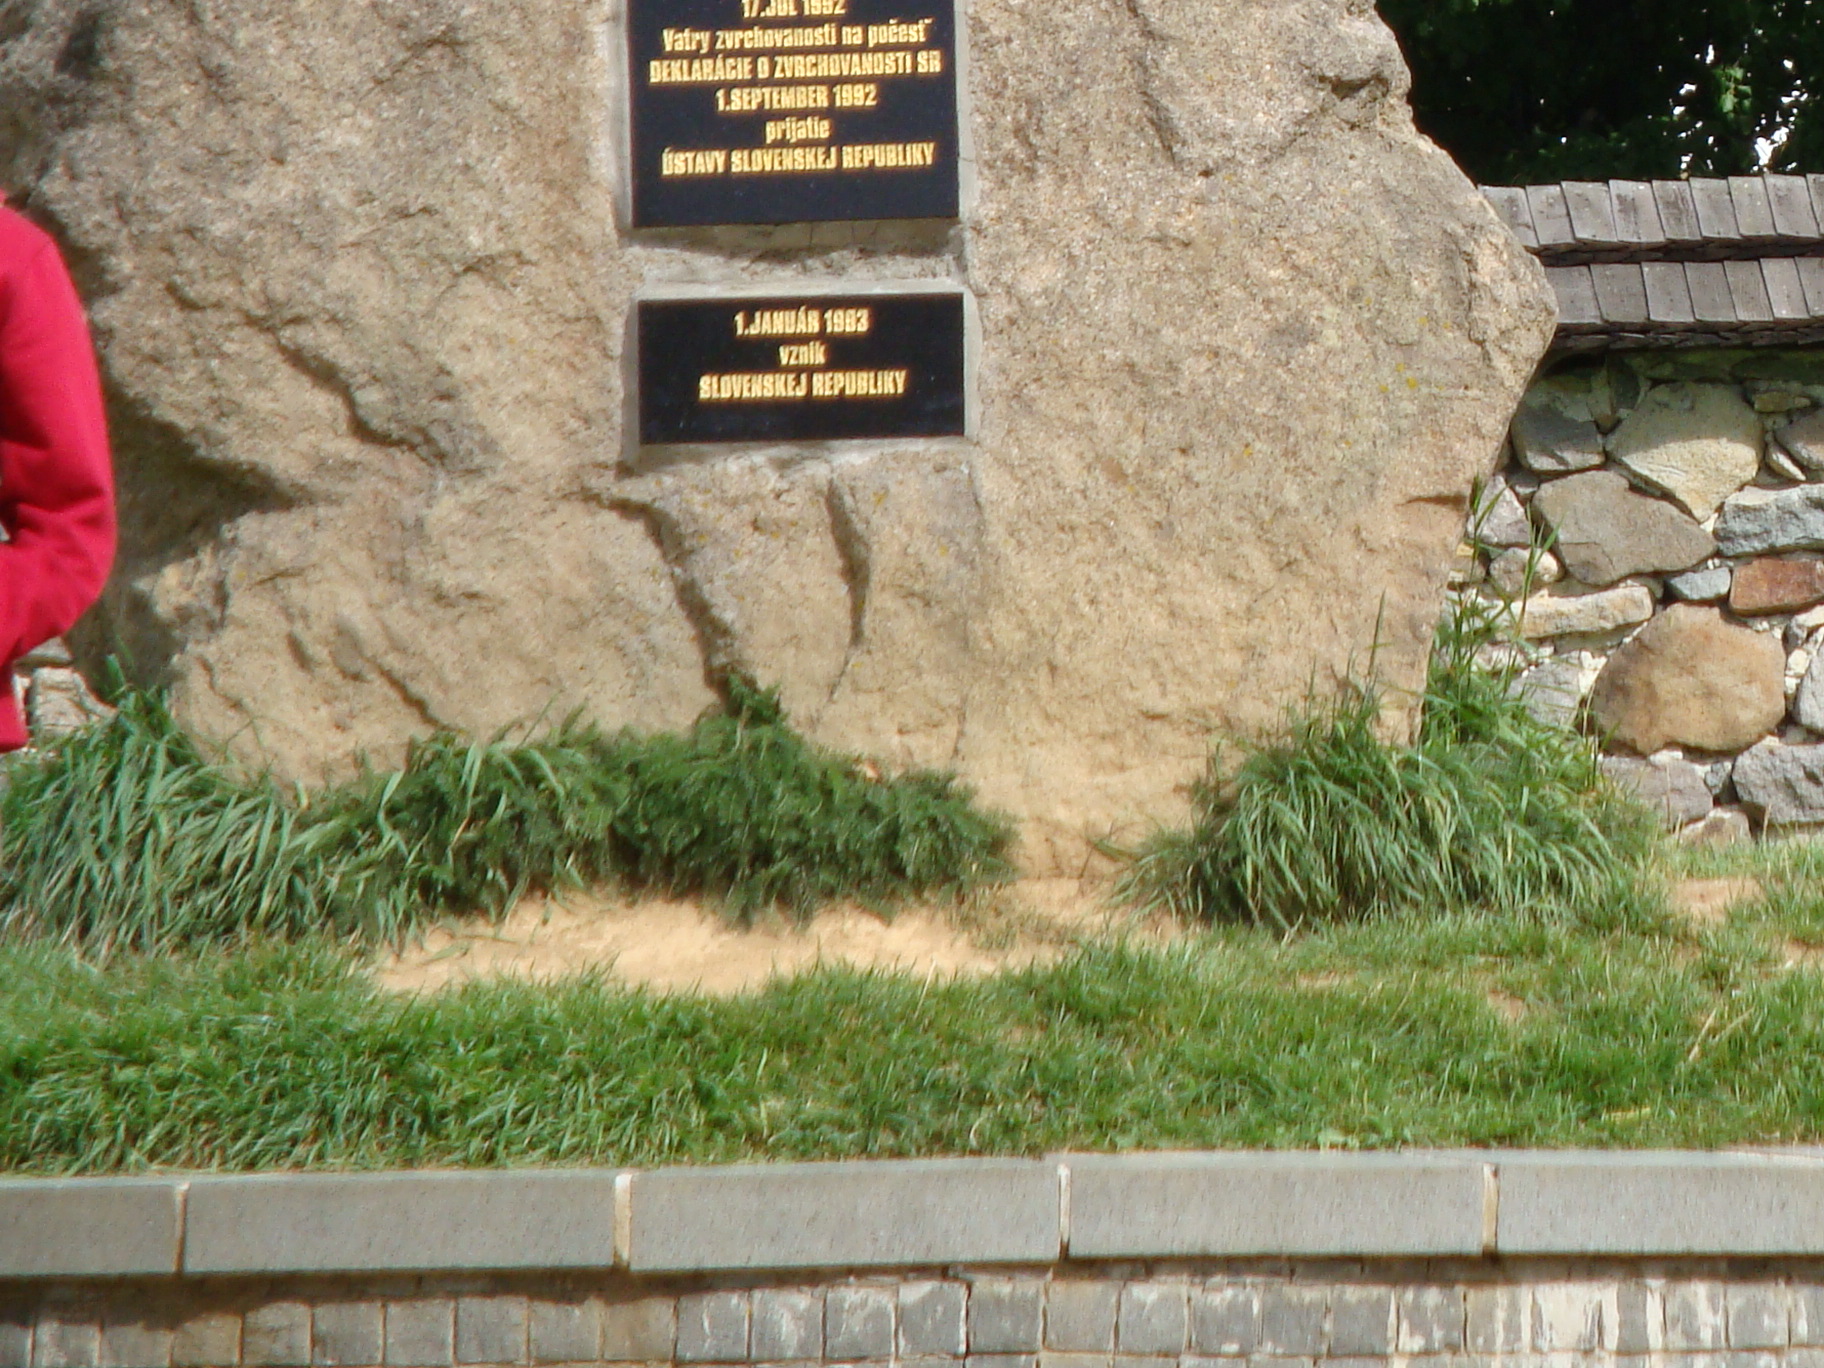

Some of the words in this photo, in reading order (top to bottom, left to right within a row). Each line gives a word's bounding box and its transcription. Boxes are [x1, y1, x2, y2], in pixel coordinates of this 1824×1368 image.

[662, 28, 710, 54] Vatry
[716, 23, 836, 50] zvrchovanosti
[842, 24, 862, 44] na
[650, 56, 752, 83] DEKLARÁCIE
[758, 59, 769, 79] O
[774, 53, 912, 78] ZVRCHOVANOSTI
[918, 51, 941, 73] SR
[716, 86, 829, 113] 1.SEPTEMBER
[833, 84, 877, 108] 1992
[765, 116, 831, 144] prijatie
[662, 148, 725, 176] ÚSTAVY
[731, 147, 837, 172] SLOVENSKEJ
[842, 143, 934, 168] REPUBLIKY
[734, 306, 819, 336] 1.JANUÁR
[699, 374, 807, 399] SLOVENSKEJ
[812, 369, 907, 396] REPUBLIKY
